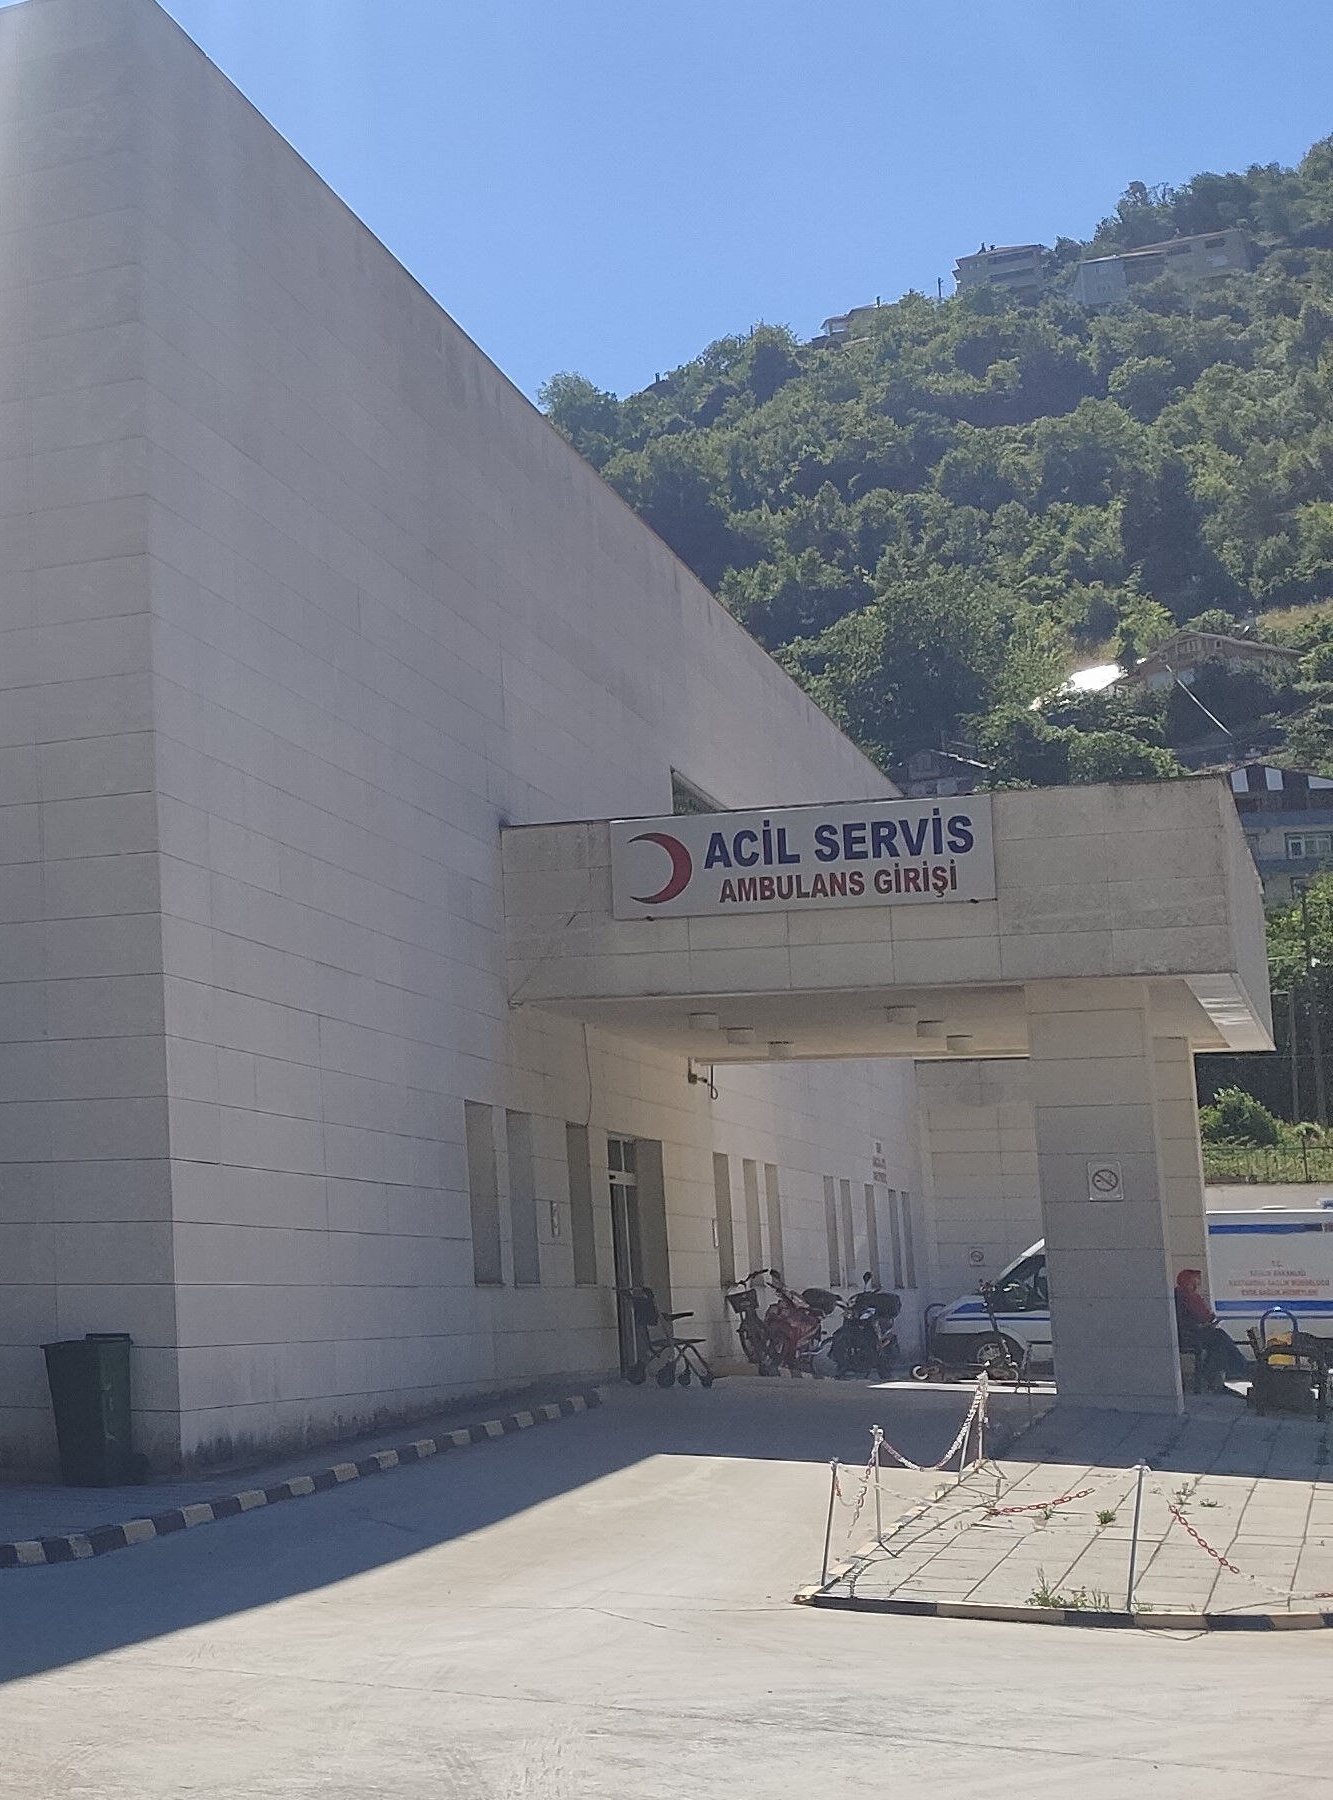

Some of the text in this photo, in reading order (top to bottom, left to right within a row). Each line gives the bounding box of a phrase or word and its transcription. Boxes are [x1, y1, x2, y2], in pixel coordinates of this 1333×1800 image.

[703, 807, 974, 869] ACİL SERVİS
[720, 859, 958, 903] AMBULANS GİRİŞİ
